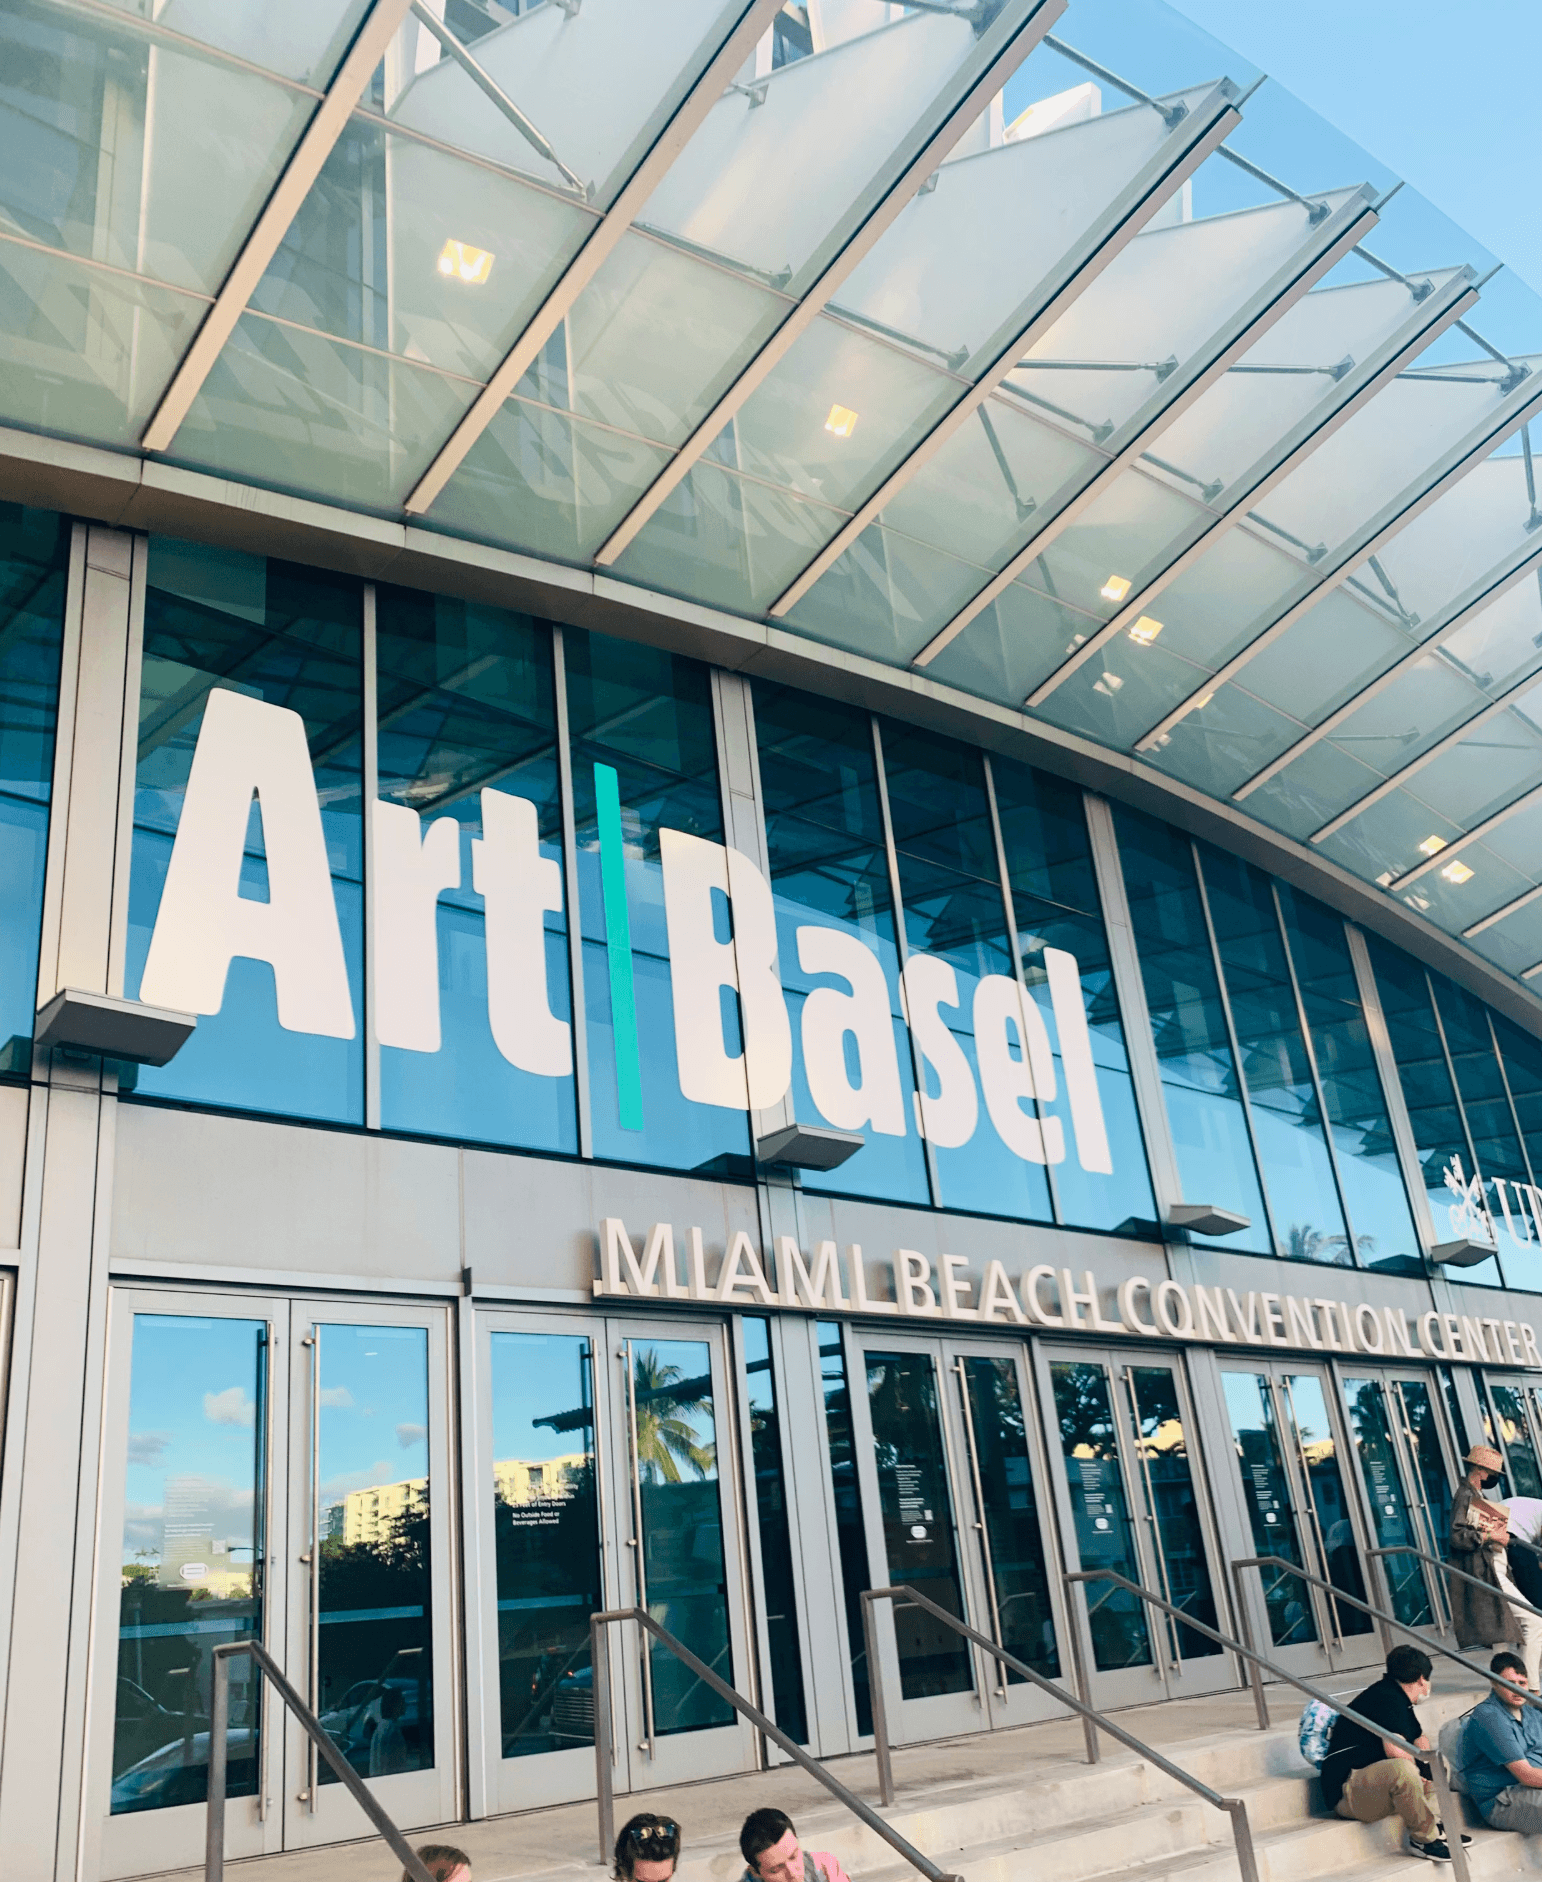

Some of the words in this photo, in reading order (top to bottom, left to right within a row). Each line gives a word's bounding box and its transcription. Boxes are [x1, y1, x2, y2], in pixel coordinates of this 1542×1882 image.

[139, 687, 573, 1077] Art
[659, 827, 1113, 1175] Basel
[600, 1217, 867, 1310] MIAMI
[893, 1248, 1101, 1329] BEACH
[1117, 1276, 1412, 1355] CONVENTION
[1417, 1310, 1542, 1366] CENTER
